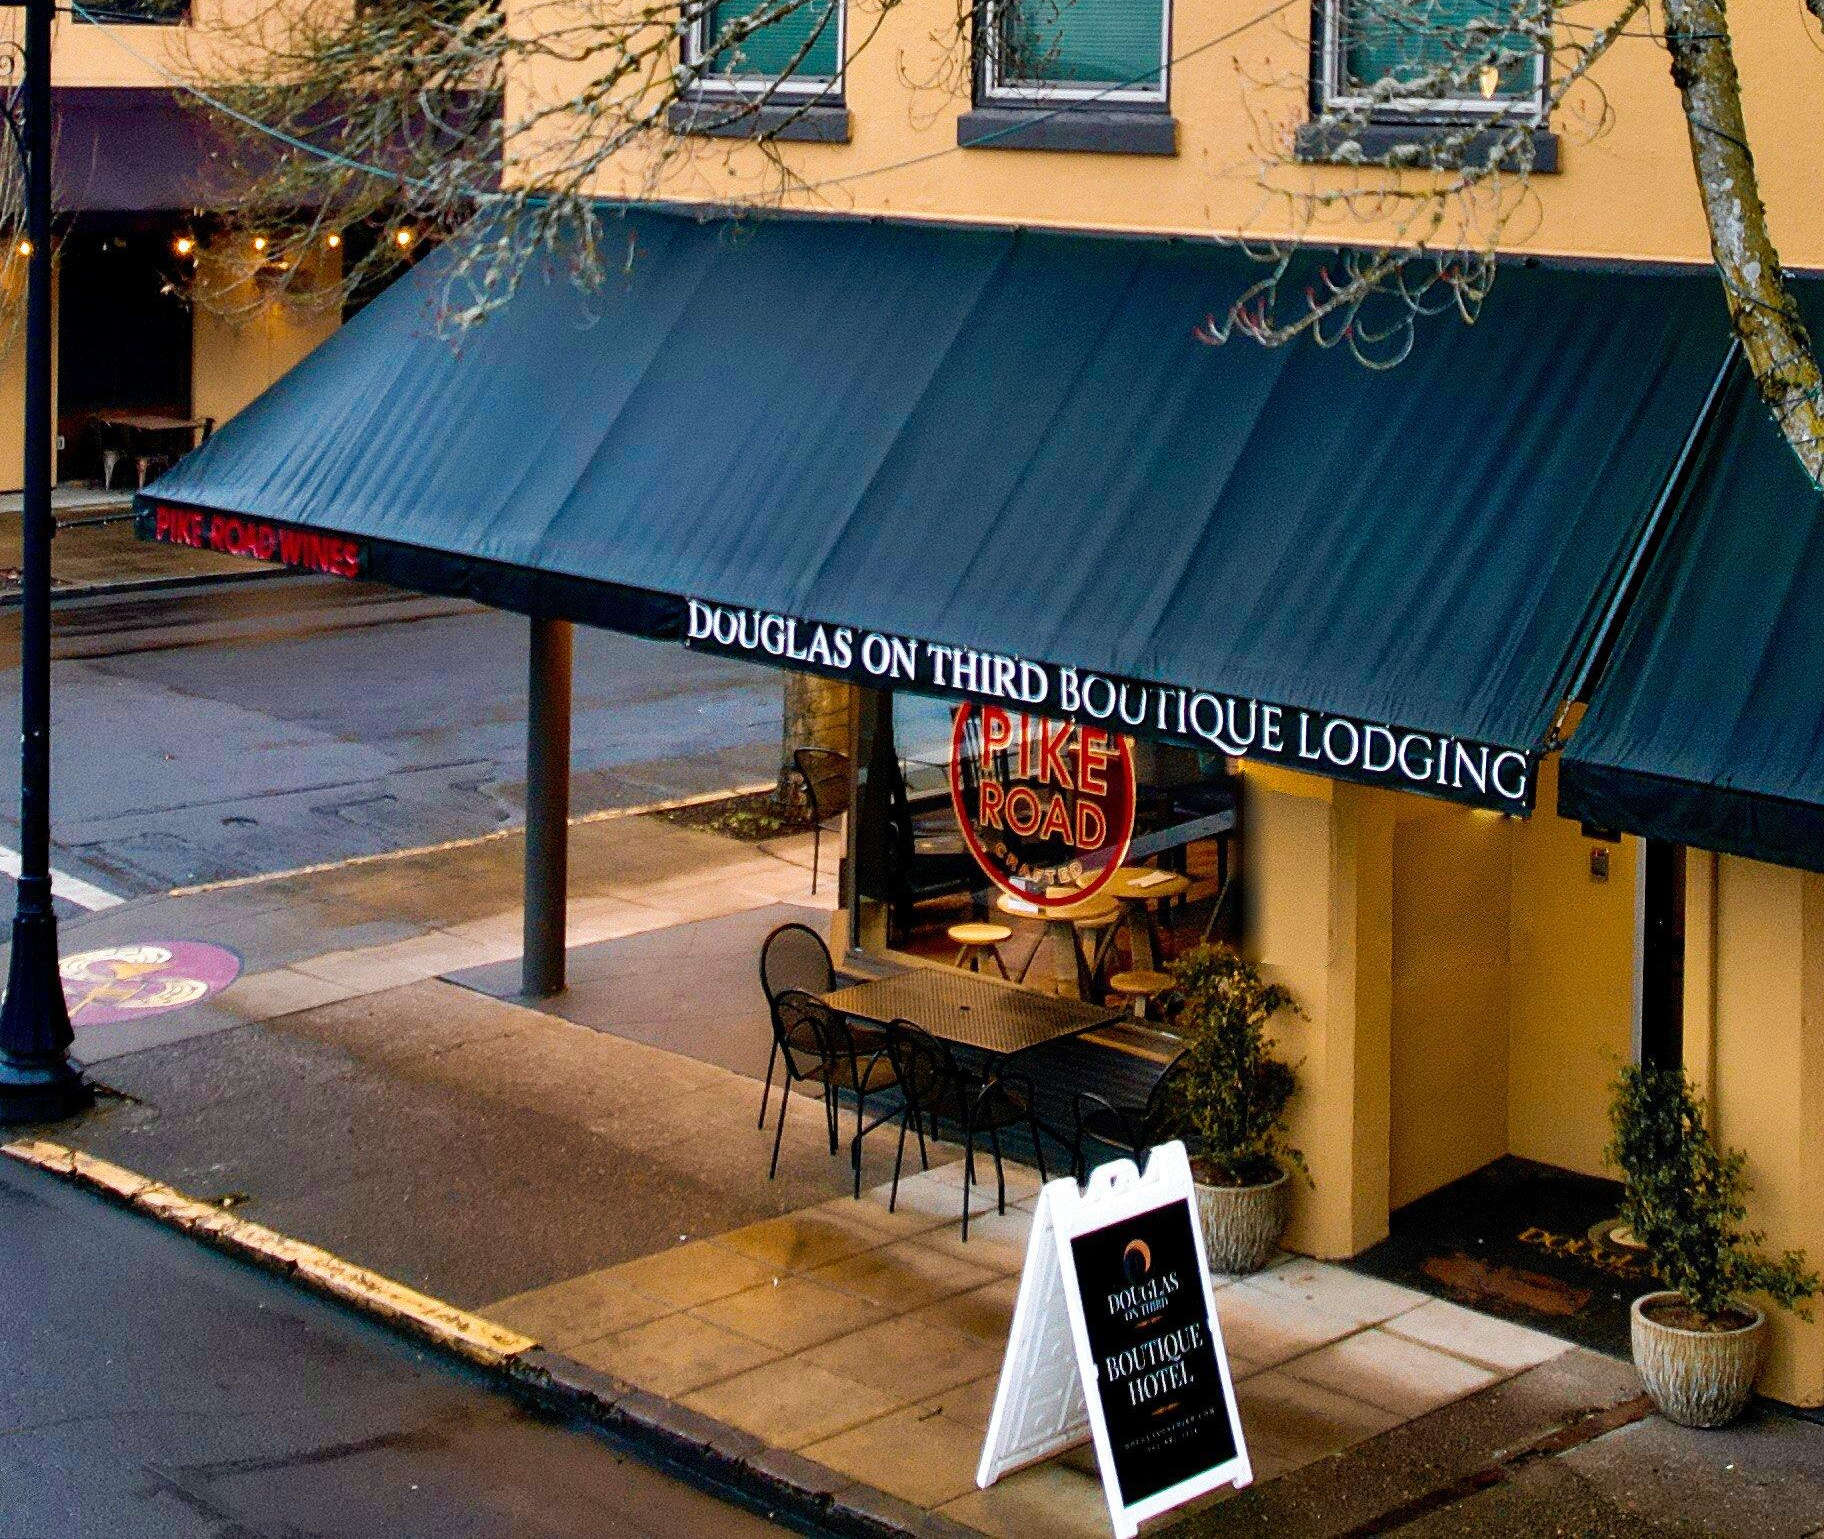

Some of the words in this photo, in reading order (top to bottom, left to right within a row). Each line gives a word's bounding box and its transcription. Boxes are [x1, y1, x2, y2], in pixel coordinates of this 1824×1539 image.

[155, 504, 205, 549] PIKE
[209, 514, 276, 560] ROAD
[278, 527, 360, 579] WINES
[687, 599, 854, 669] DOUGLAS
[861, 633, 918, 681] ON
[926, 645, 1049, 704] THIRD
[1060, 667, 1283, 756] BOUTIQUE
[1298, 711, 1528, 801] LODGING
[981, 704, 1108, 797] PIKE
[979, 779, 1107, 850] ROAD
[1107, 1271, 1179, 1315] DOUGLAS
[1105, 1323, 1203, 1382] BOUTIQUE
[1128, 1360, 1194, 1406] HOTEL
